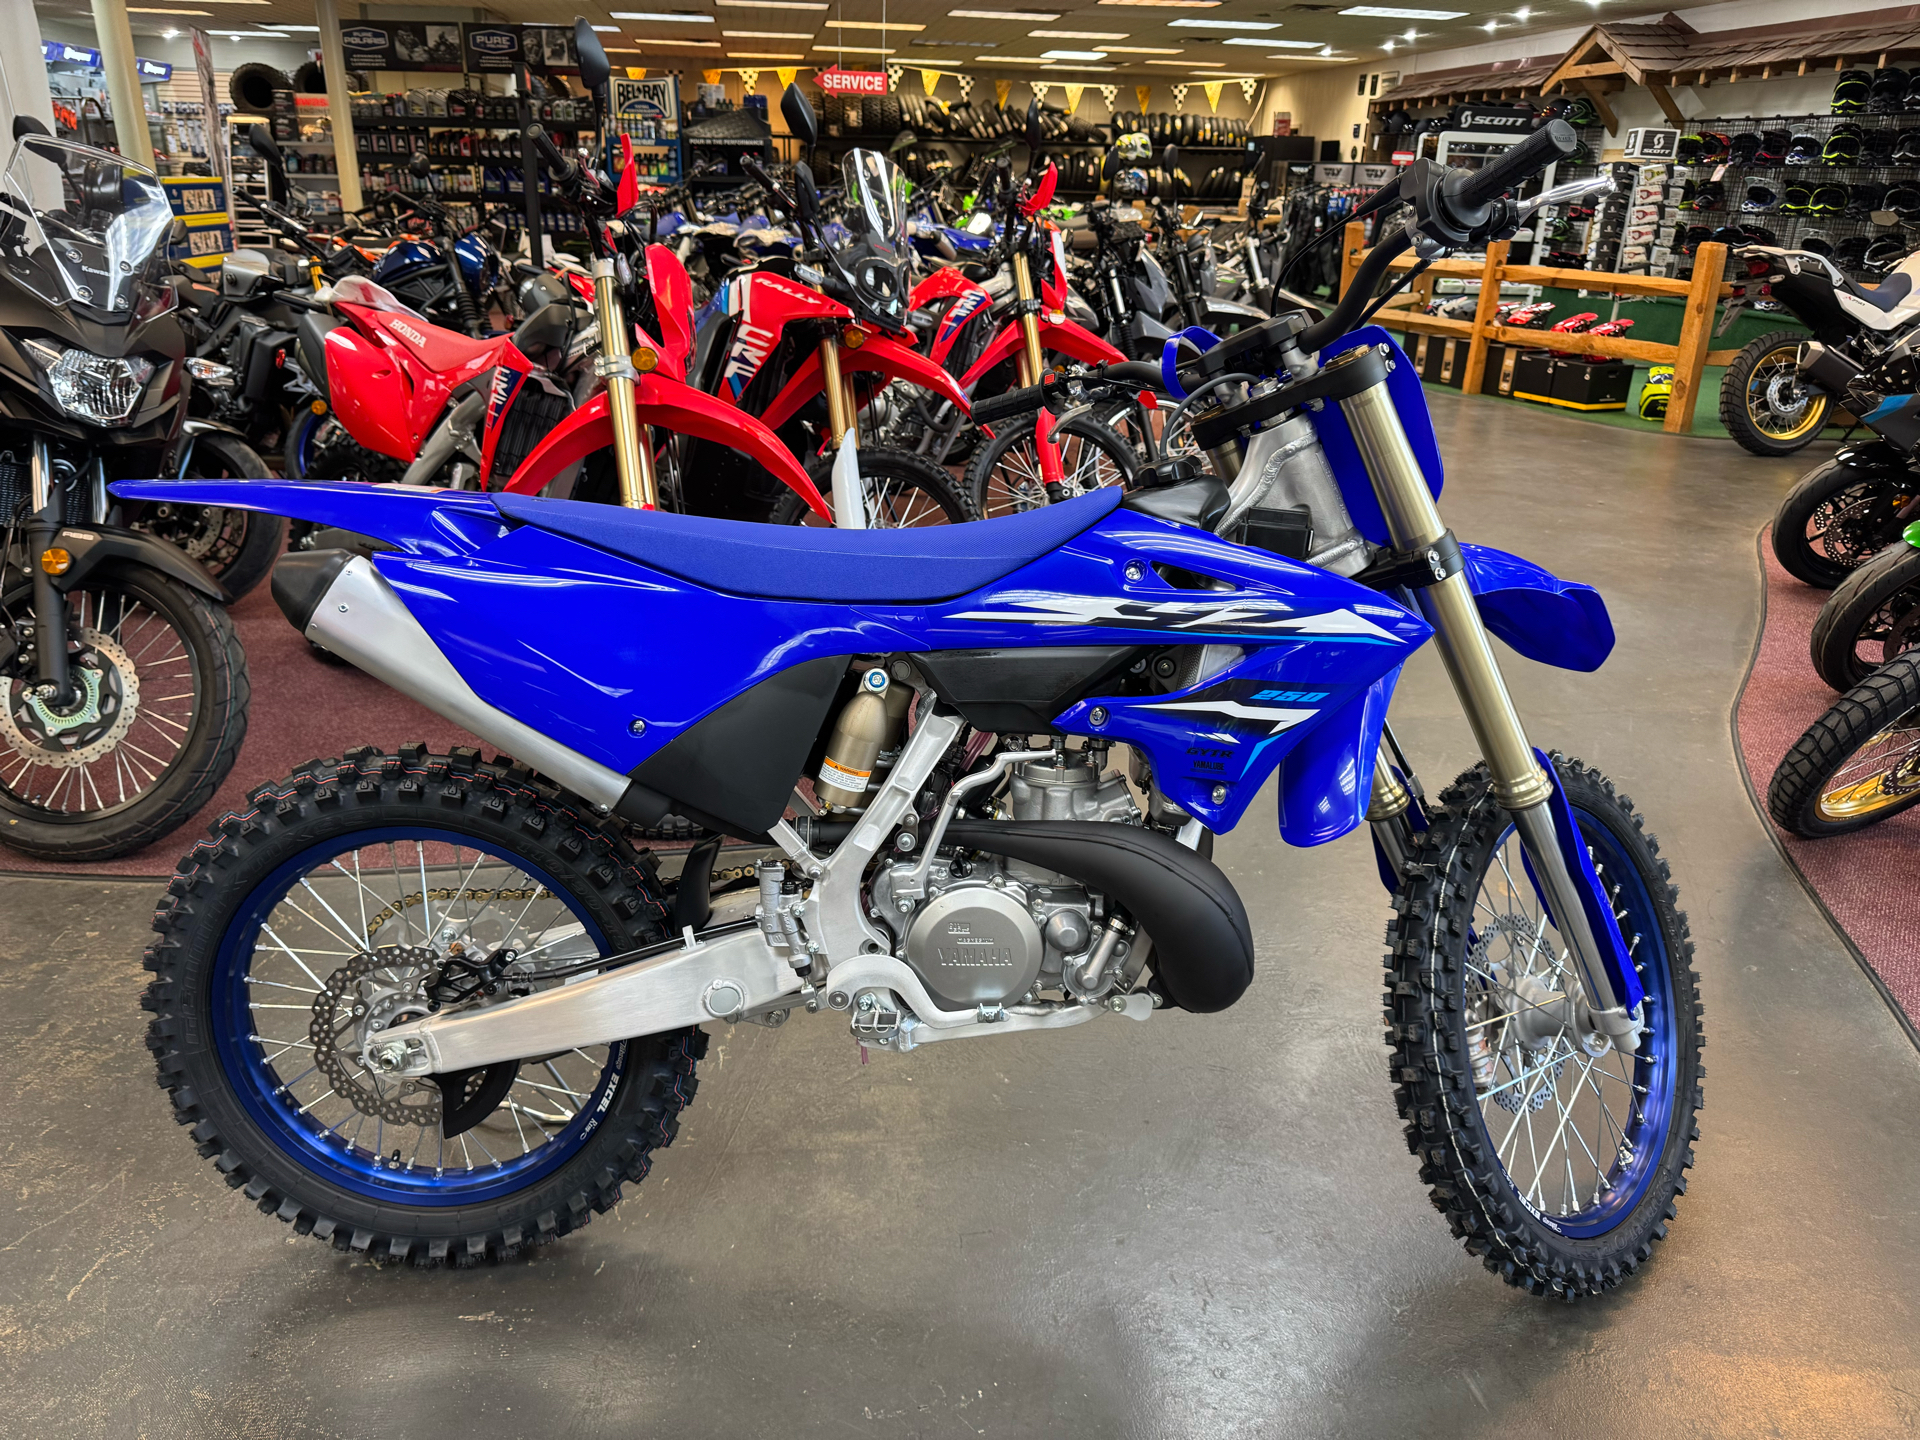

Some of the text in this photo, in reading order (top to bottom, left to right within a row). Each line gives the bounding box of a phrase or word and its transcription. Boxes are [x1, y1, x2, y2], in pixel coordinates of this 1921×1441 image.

[475, 35, 512, 45] PURE
[822, 73, 884, 91] SERVICE
[1471, 115, 1527, 127] SCOTT
[754, 278, 822, 305] RALLY
[389, 319, 427, 348] HONDA
[62, 531, 94, 541] ABS
[1249, 689, 1331, 703] 250
[1186, 747, 1235, 758] GYTR
[1193, 760, 1225, 771] YAMALUBE
[938, 947, 1012, 966] YAMAHA
[597, 1072, 620, 1113] EXCEL
[1517, 1190, 1541, 1221] EXCEL
